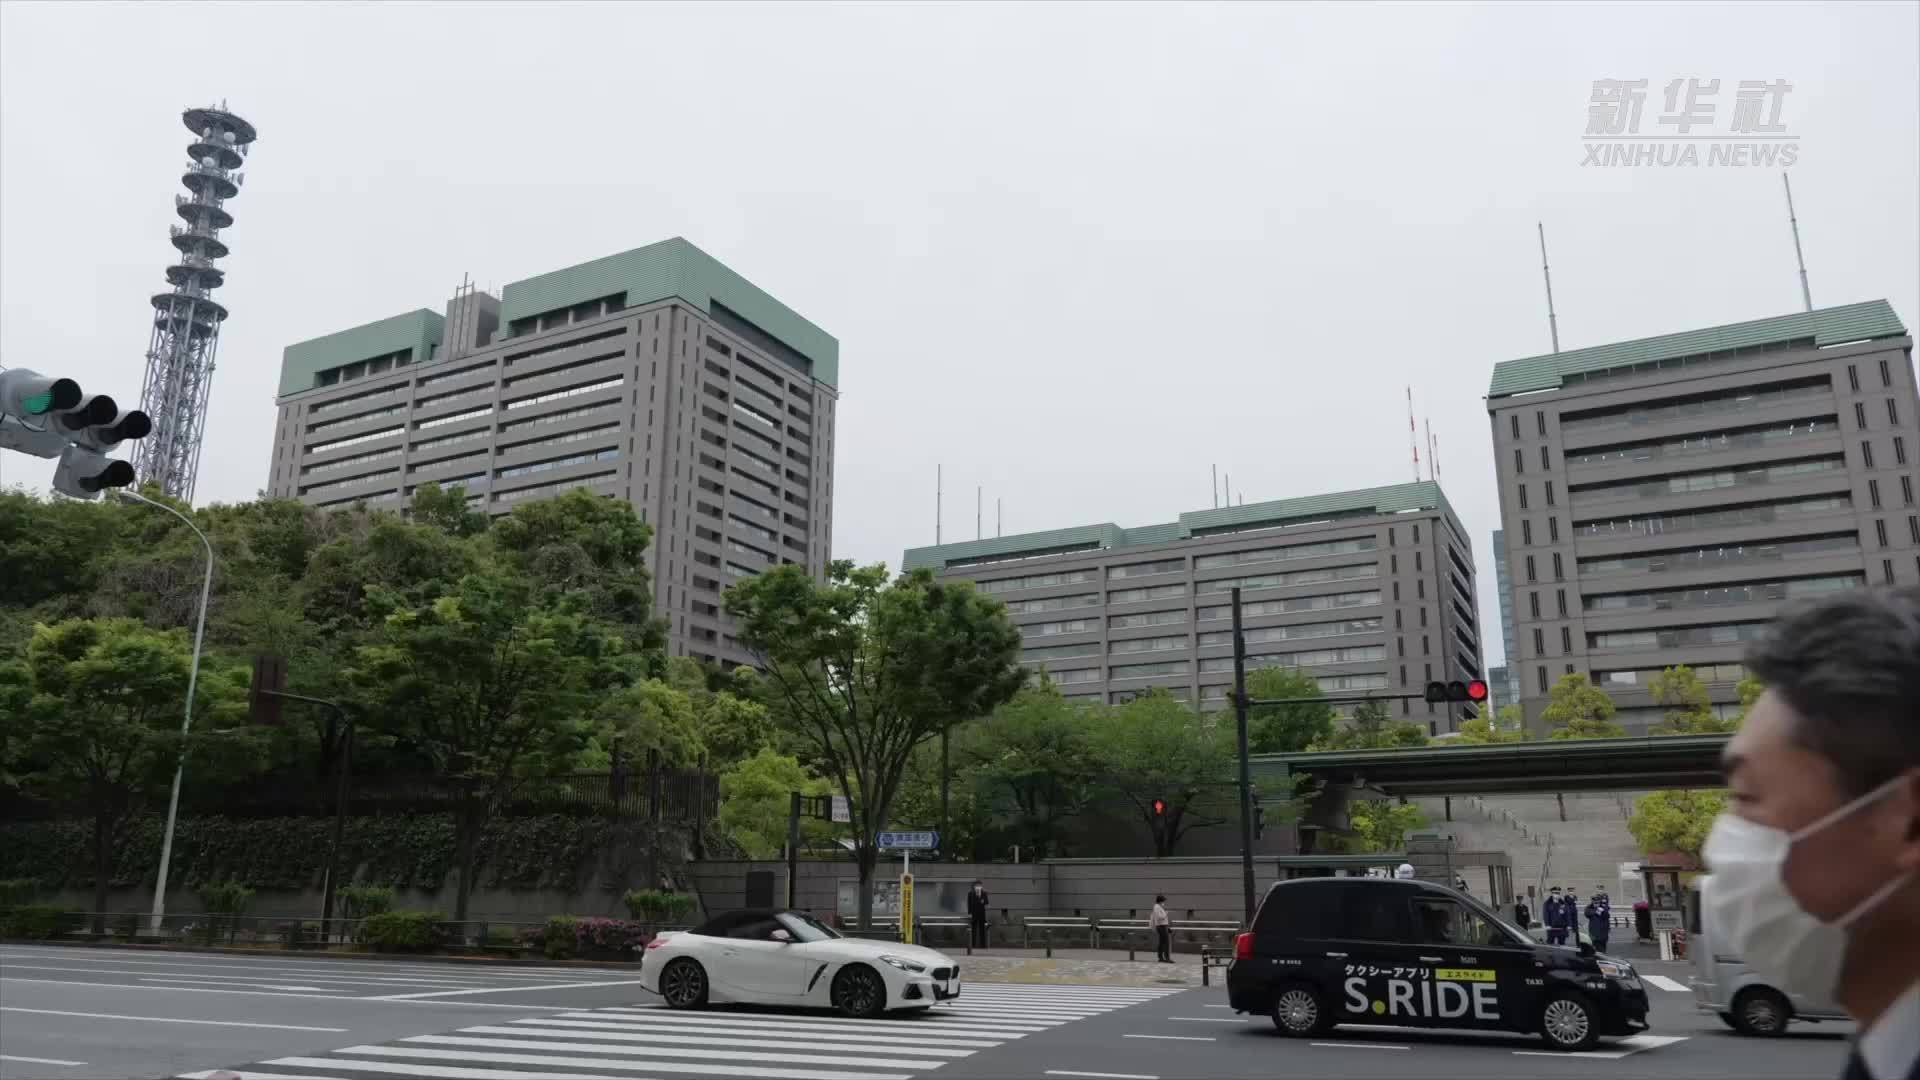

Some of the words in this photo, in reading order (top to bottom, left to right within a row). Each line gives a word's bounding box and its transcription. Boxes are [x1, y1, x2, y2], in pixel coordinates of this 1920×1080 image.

[1344, 964, 1430, 978] タクシーアプリ
